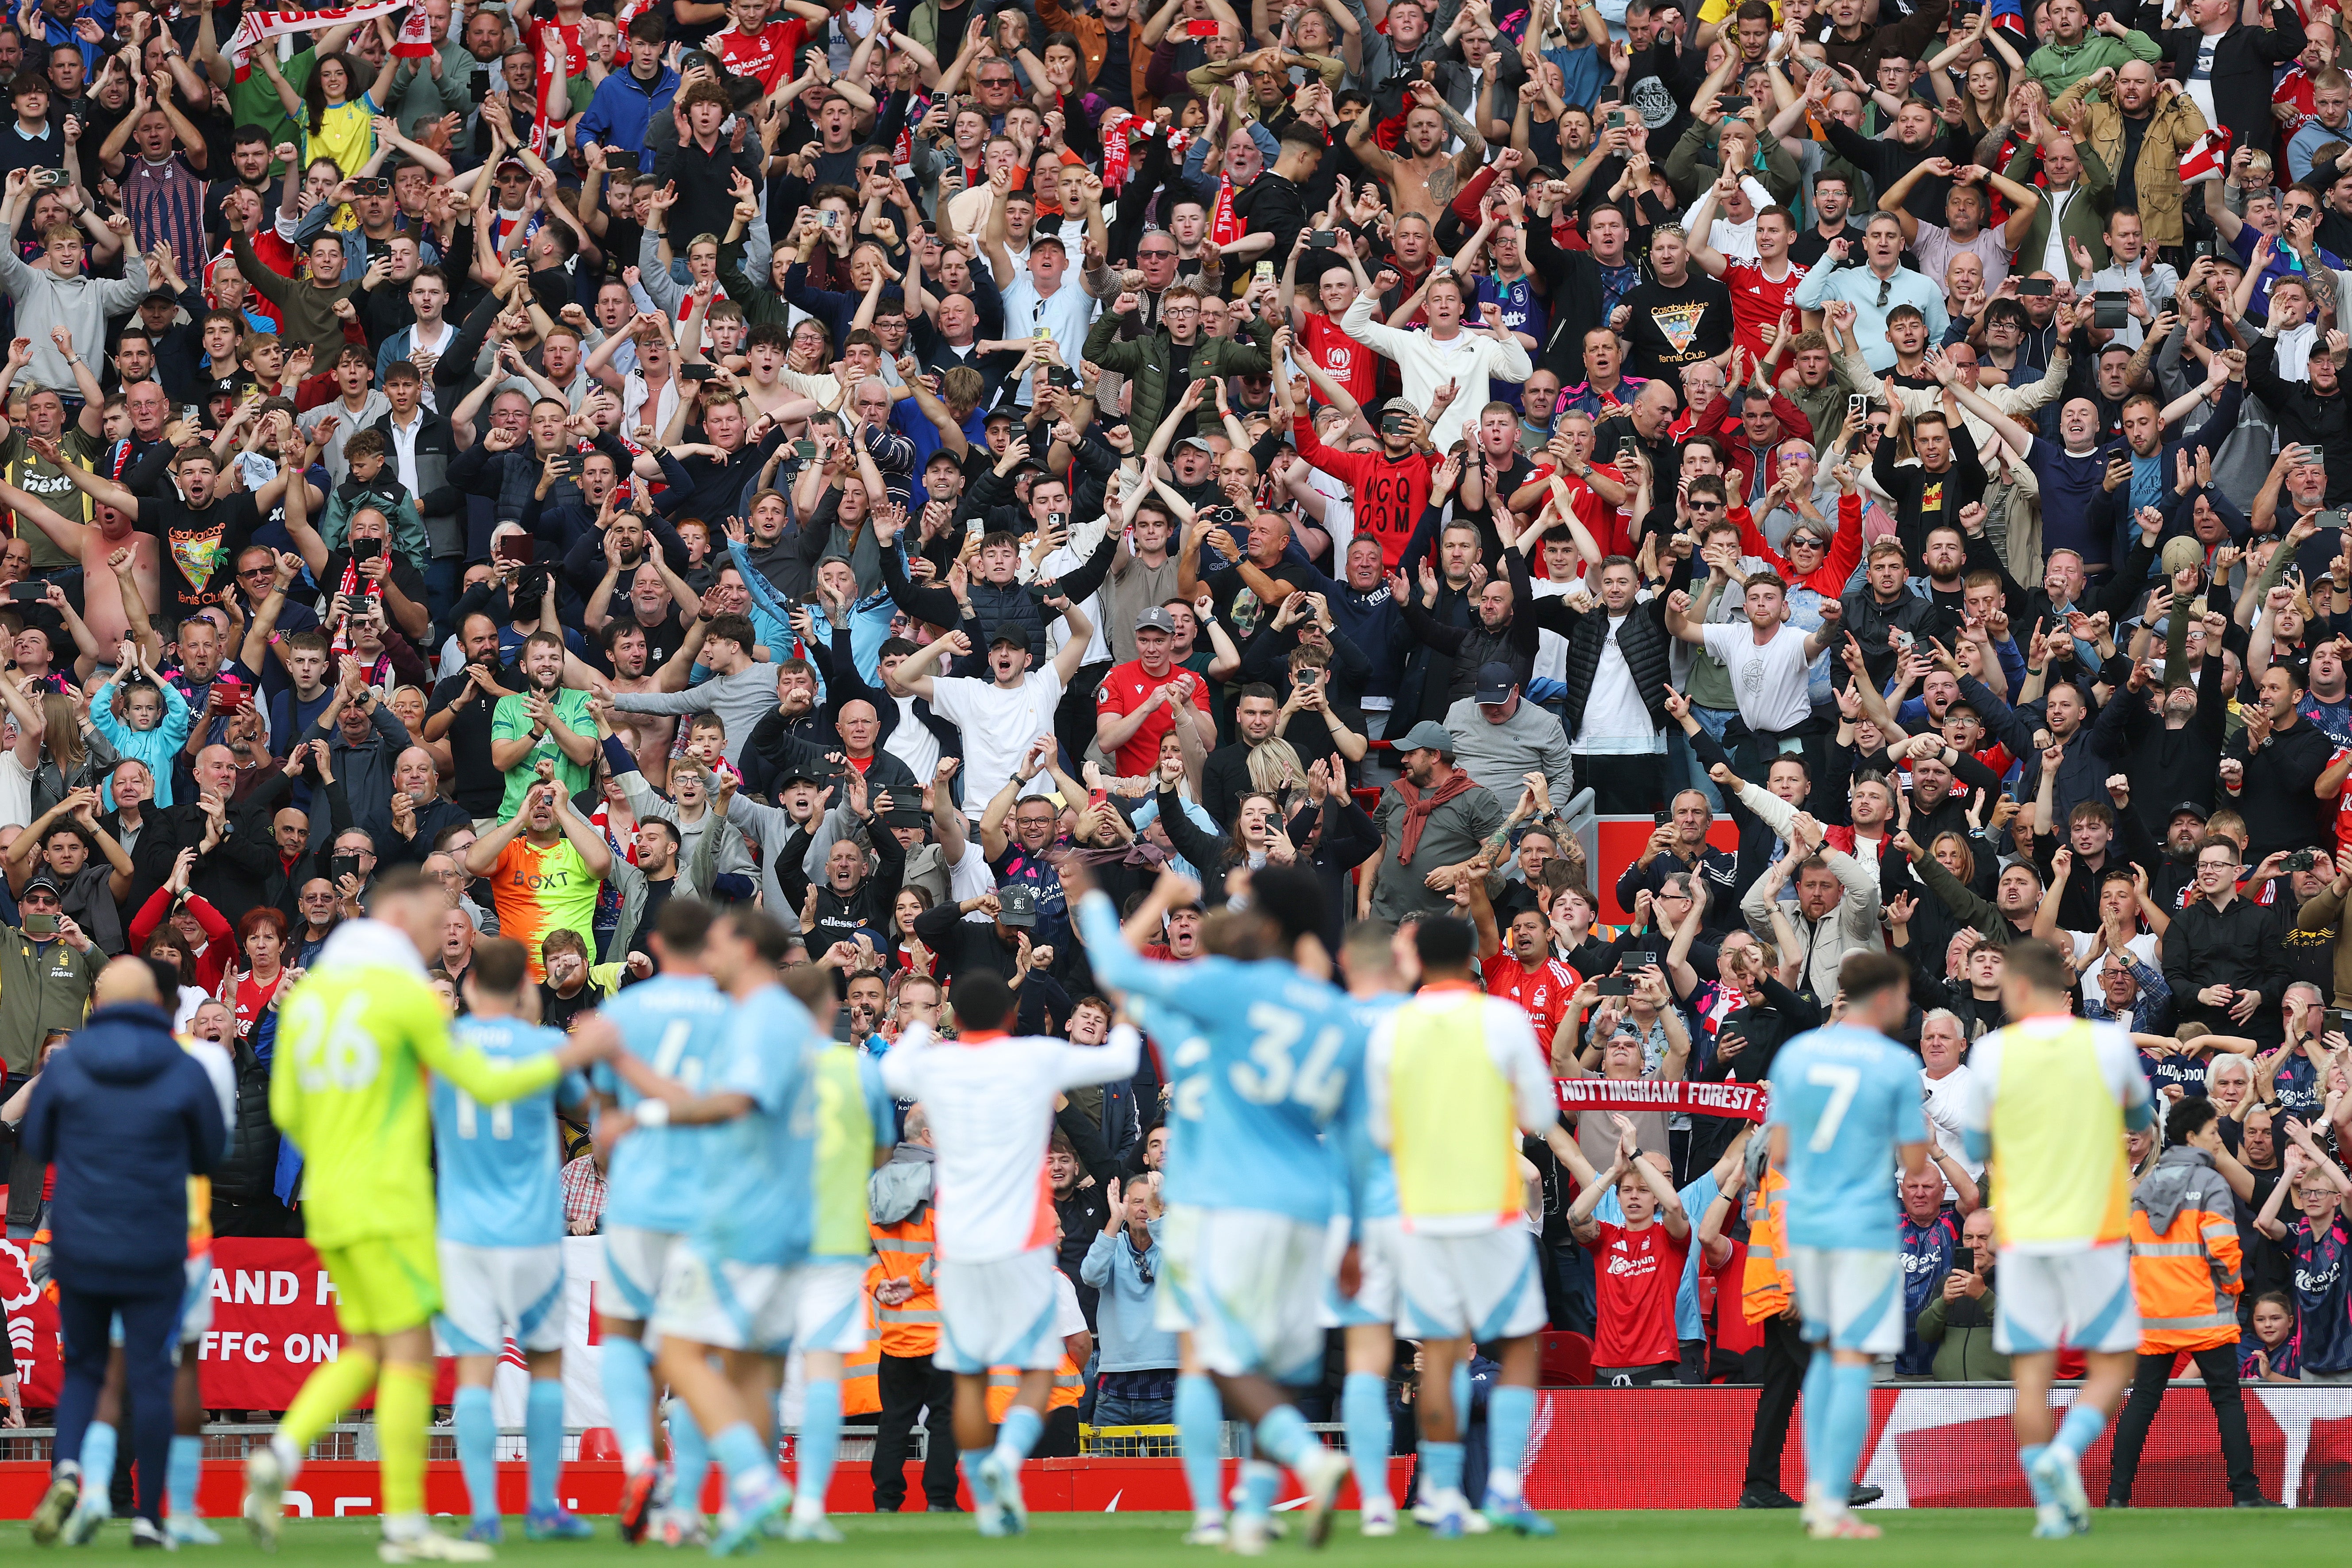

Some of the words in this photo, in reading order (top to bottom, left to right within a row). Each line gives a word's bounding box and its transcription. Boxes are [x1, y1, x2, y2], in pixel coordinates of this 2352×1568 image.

[1658, 354, 1683, 363] Tennis
[1684, 350, 1706, 361] Club
[1323, 368, 1351, 377] UNHCR
[23, 475, 72, 493] next
[1366, 586, 1391, 607] POLO
[514, 870, 568, 890] BOXT
[820, 916, 858, 928] ellesse
[294, 991, 383, 1095] 26
[1229, 999, 1348, 1127] 34
[1559, 1080, 1680, 1104] NOTTINGHAM
[1687, 1082, 1758, 1111] FOREST
[1806, 1063, 1860, 1153] 7
